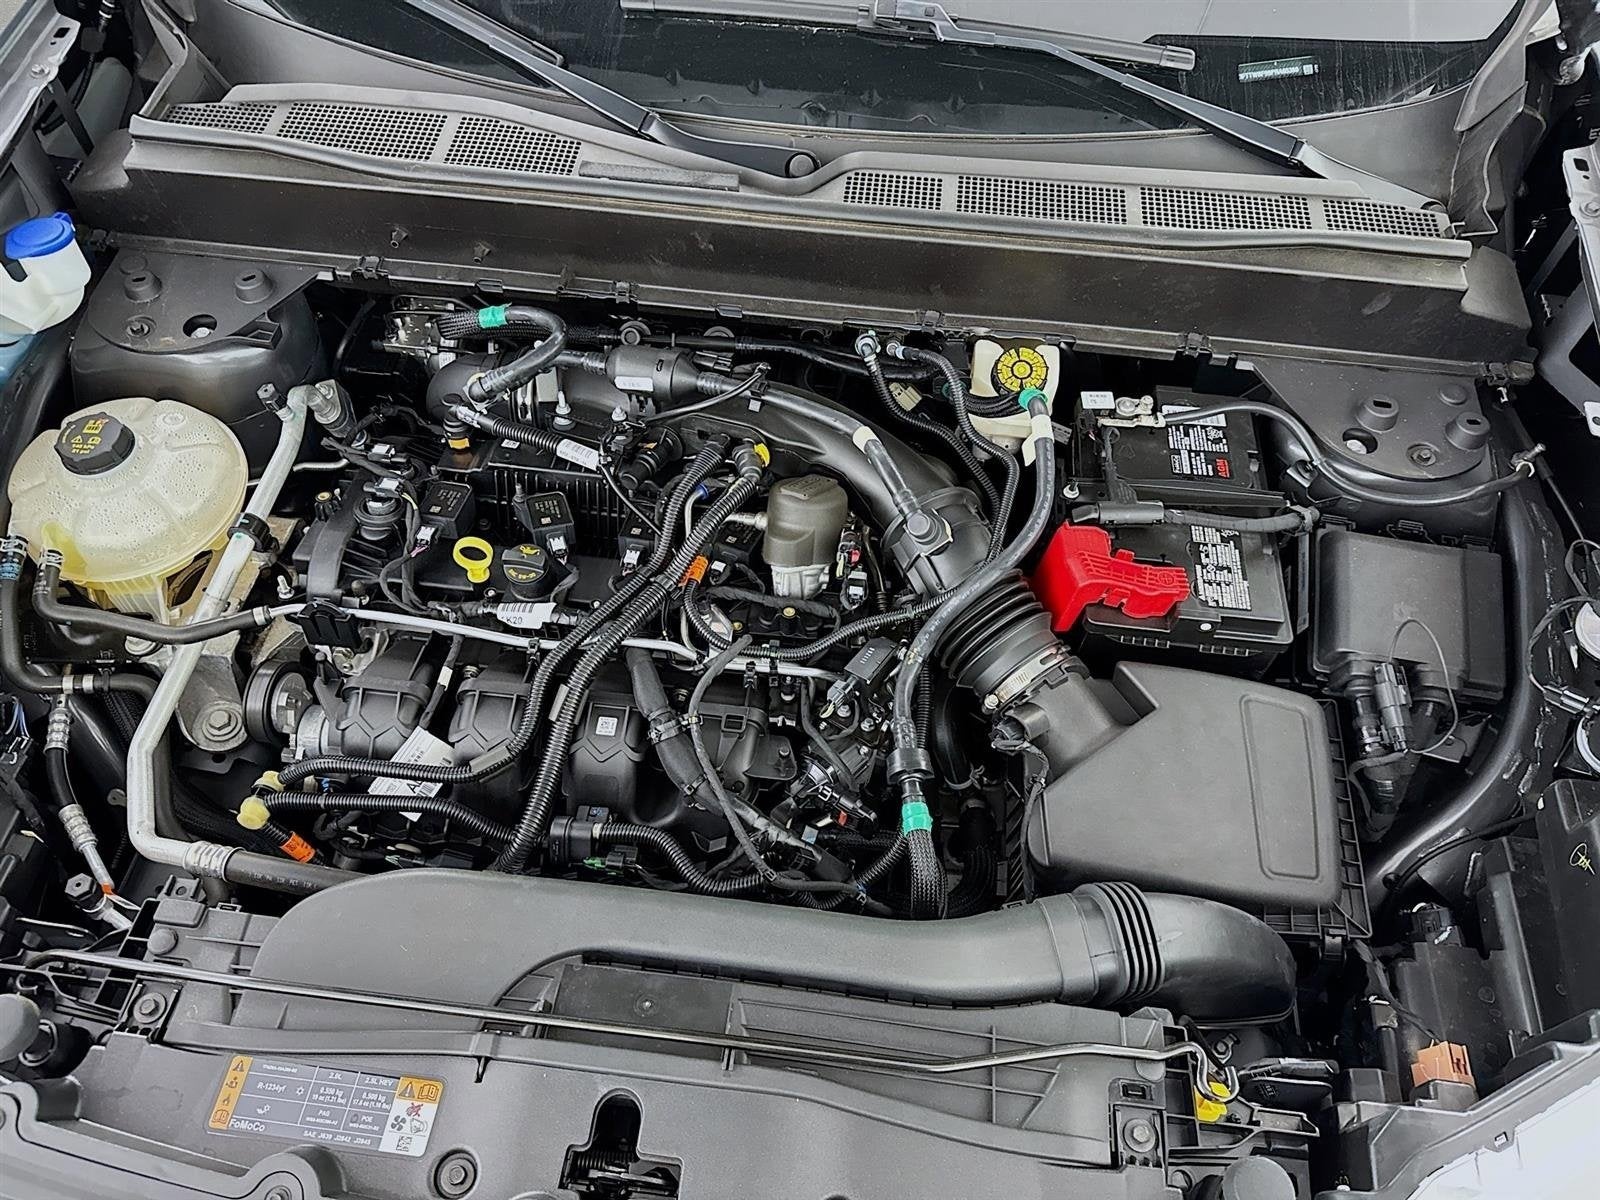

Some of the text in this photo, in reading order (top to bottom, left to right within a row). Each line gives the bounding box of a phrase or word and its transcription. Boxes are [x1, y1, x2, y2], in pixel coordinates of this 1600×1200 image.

[1216, 458, 1228, 478] AGM
[257, 1081, 286, 1093] R-1234yf
[378, 1078, 394, 1087] HEV
[332, 1088, 344, 1097] kg
[375, 1094, 386, 1103] kg
[360, 1115, 373, 1123] POE
[230, 1118, 265, 1132] FoMoCo
[304, 1130, 316, 1138] SAE
